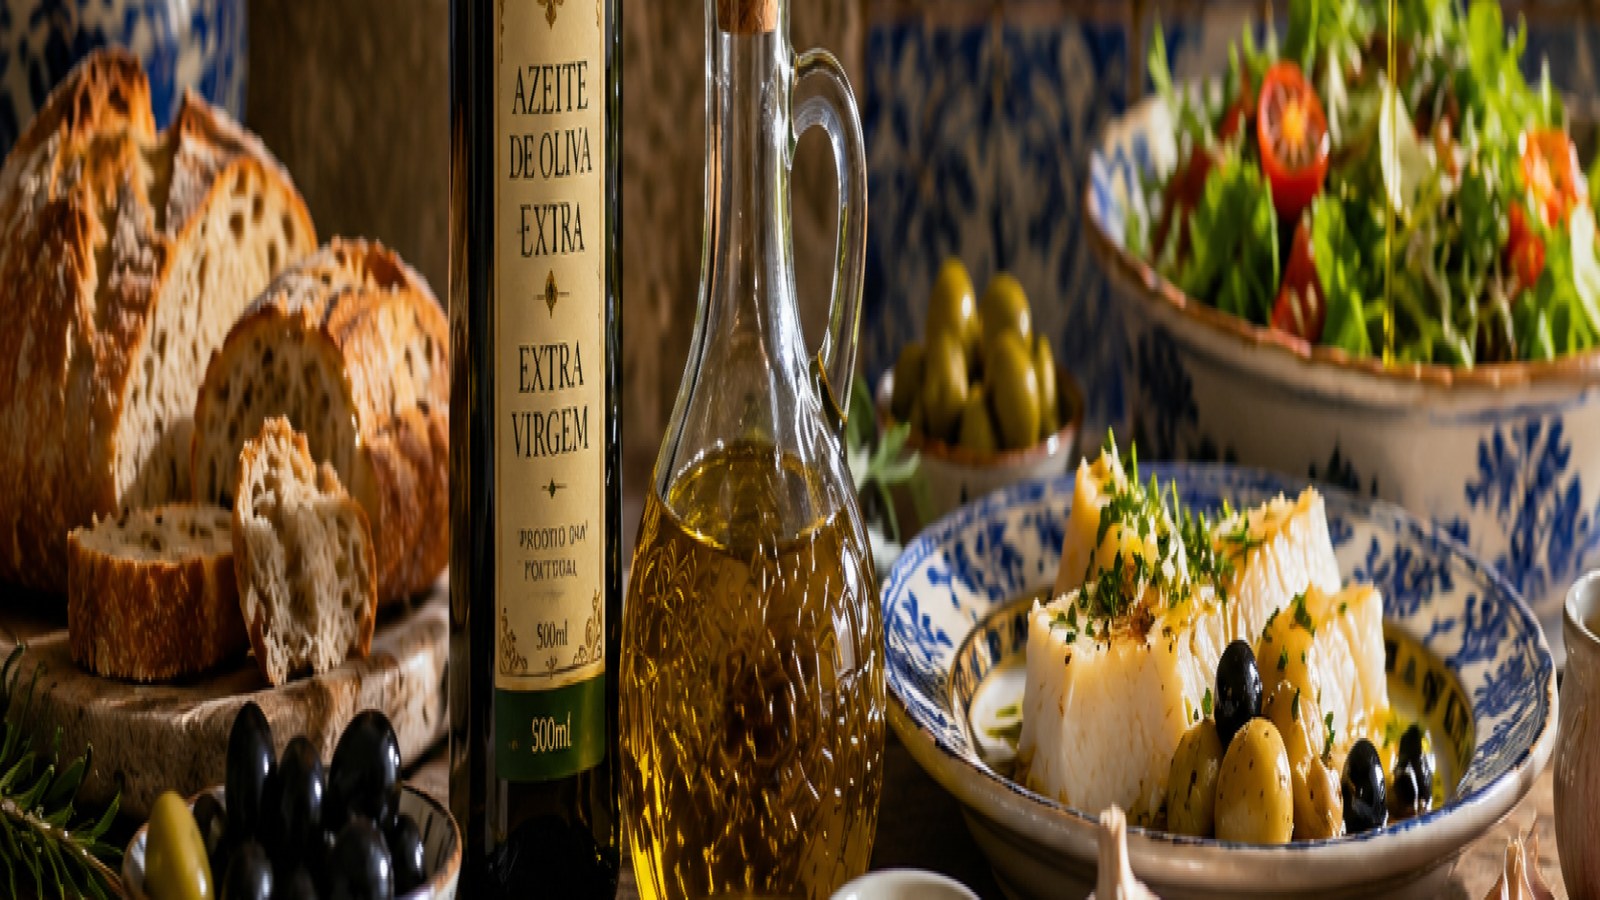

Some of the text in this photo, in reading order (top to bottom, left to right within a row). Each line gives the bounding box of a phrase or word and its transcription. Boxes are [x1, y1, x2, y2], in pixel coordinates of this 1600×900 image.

[511, 60, 589, 115] AZEITE
[509, 126, 593, 180] DE OLIVA
[519, 202, 585, 258] EXTRA
[518, 339, 584, 394] EXTRA
[511, 404, 589, 459] VIRGEM
